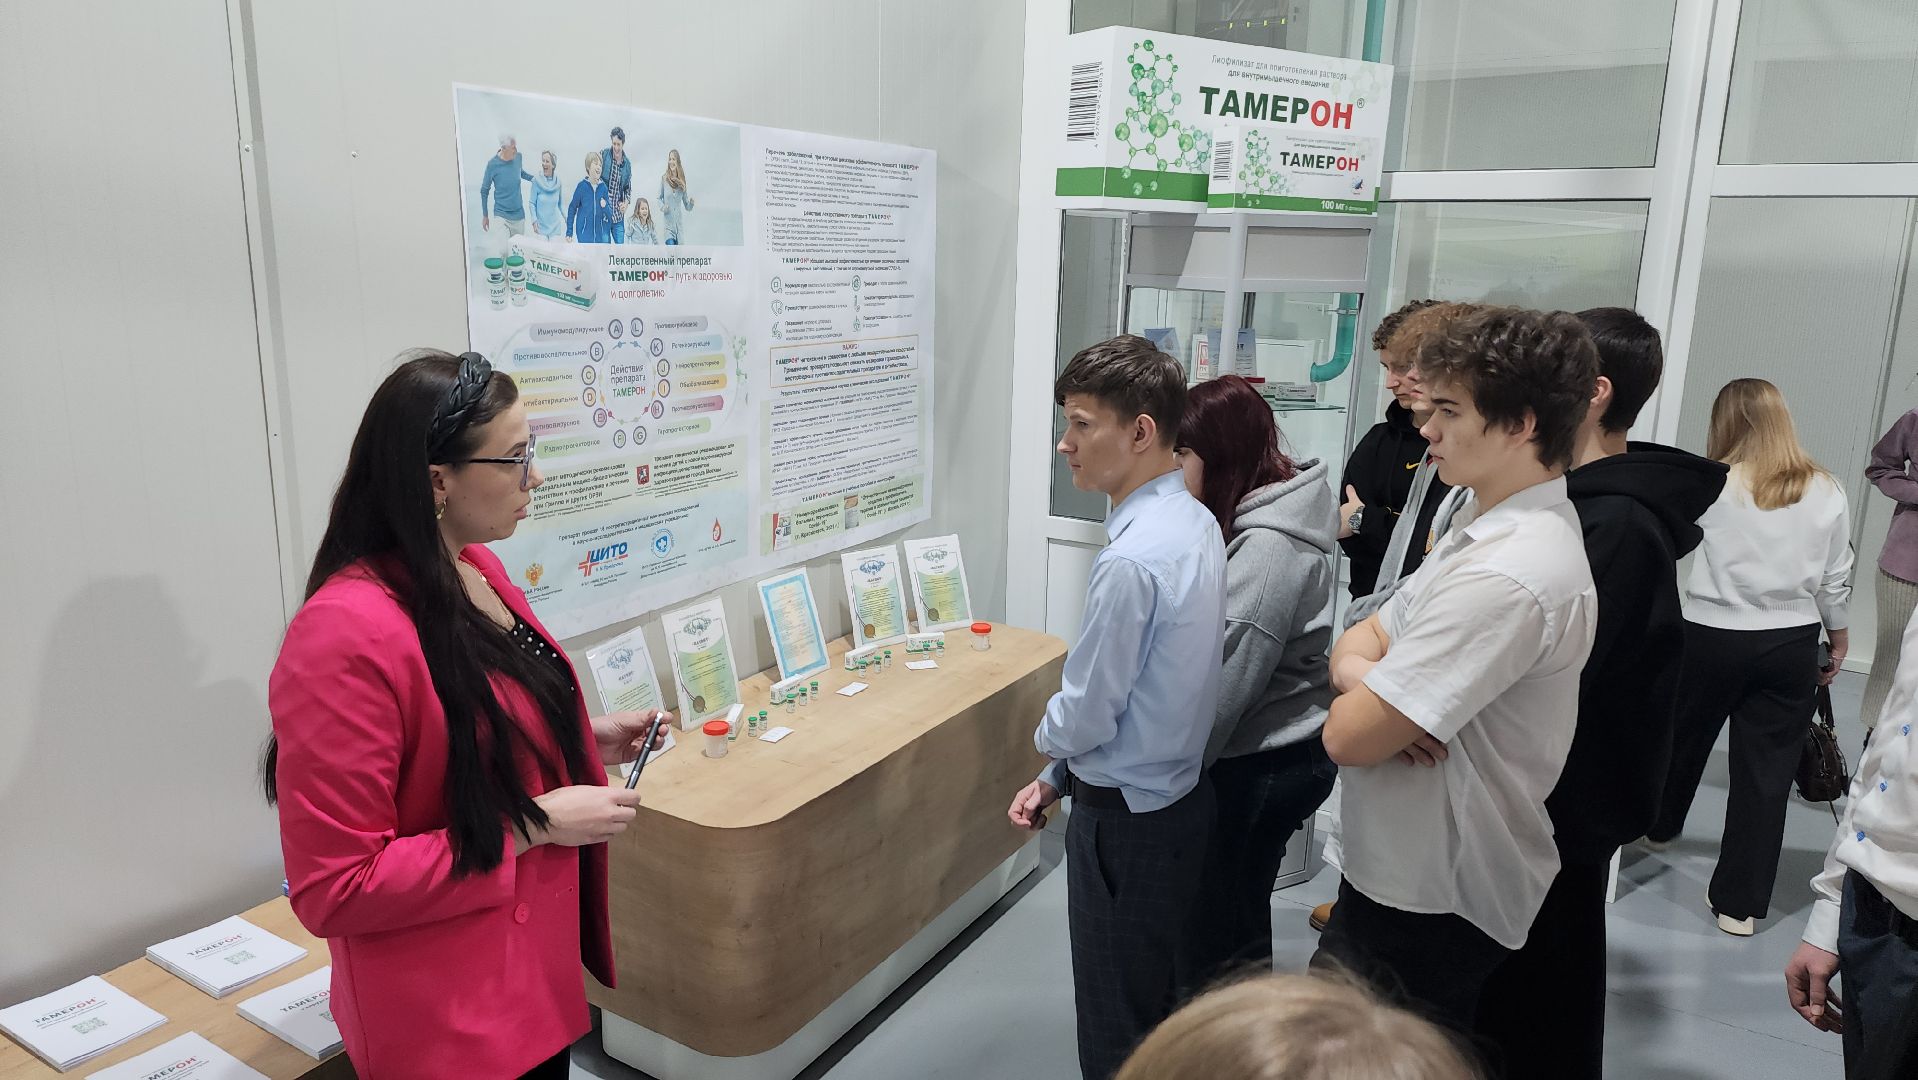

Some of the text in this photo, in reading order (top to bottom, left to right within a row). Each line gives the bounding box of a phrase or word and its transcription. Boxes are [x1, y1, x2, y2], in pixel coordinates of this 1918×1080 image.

[1228, 69, 1240, 77] для
[1320, 70, 1347, 81] раствора
[1321, 200, 1335, 210] 100
[608, 255, 712, 269] Лекарственный препарат
[675, 273, 691, 283] путь
[610, 289, 665, 300] и долголетию
[610, 364, 643, 375] Действия
[610, 374, 646, 385] препарата
[612, 386, 646, 398] ТАМЕРОН
[590, 542, 628, 563] ЦИТО
